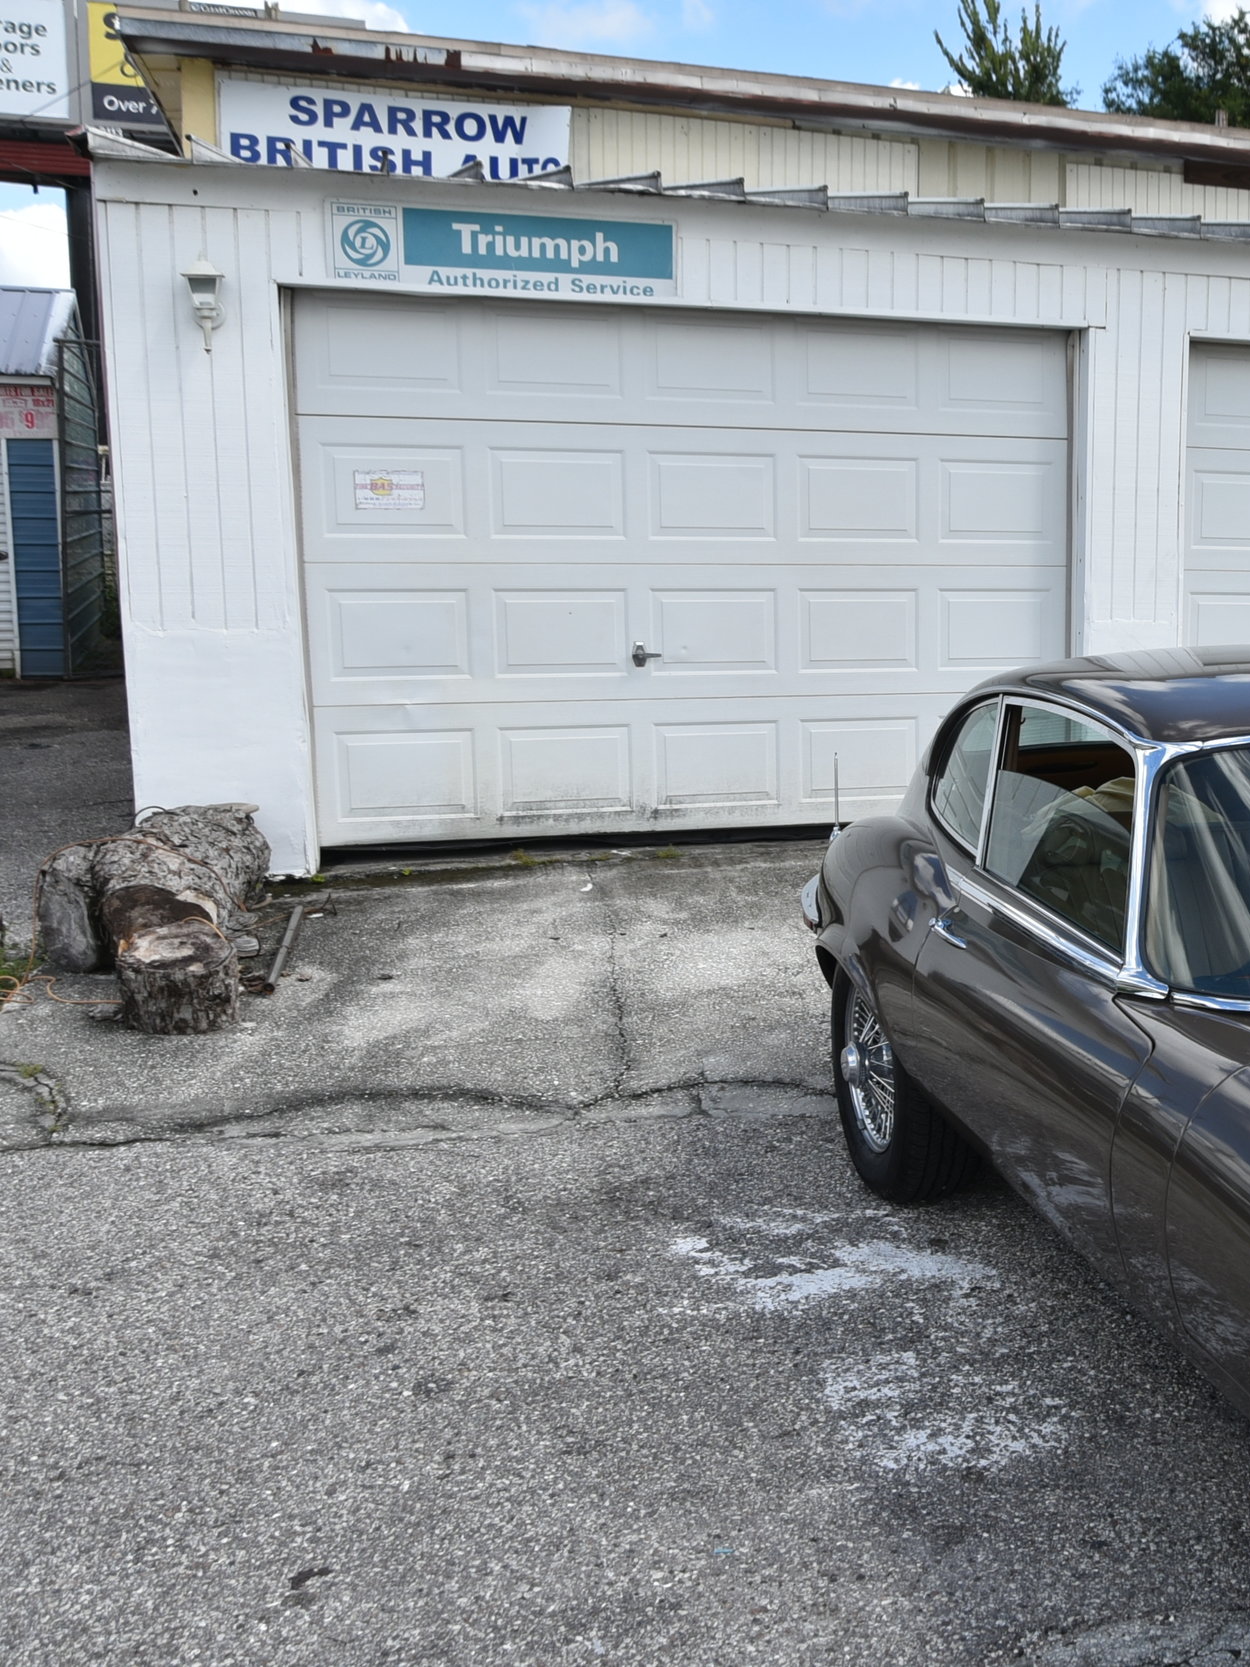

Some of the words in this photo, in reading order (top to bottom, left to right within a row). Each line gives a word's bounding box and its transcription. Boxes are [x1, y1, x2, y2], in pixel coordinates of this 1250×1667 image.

[0, 20, 47, 40] age
[0, 41, 41, 56] ors
[0, 78, 57, 95] ners
[103, 95, 146, 114] Over
[288, 95, 527, 145] SPARROW
[230, 132, 432, 177] BRITISH
[336, 205, 392, 216] BRITISH
[452, 223, 619, 268] Triumph
[337, 271, 397, 281] LEYLAND
[427, 270, 560, 292] Authorized
[570, 278, 655, 297] Service
